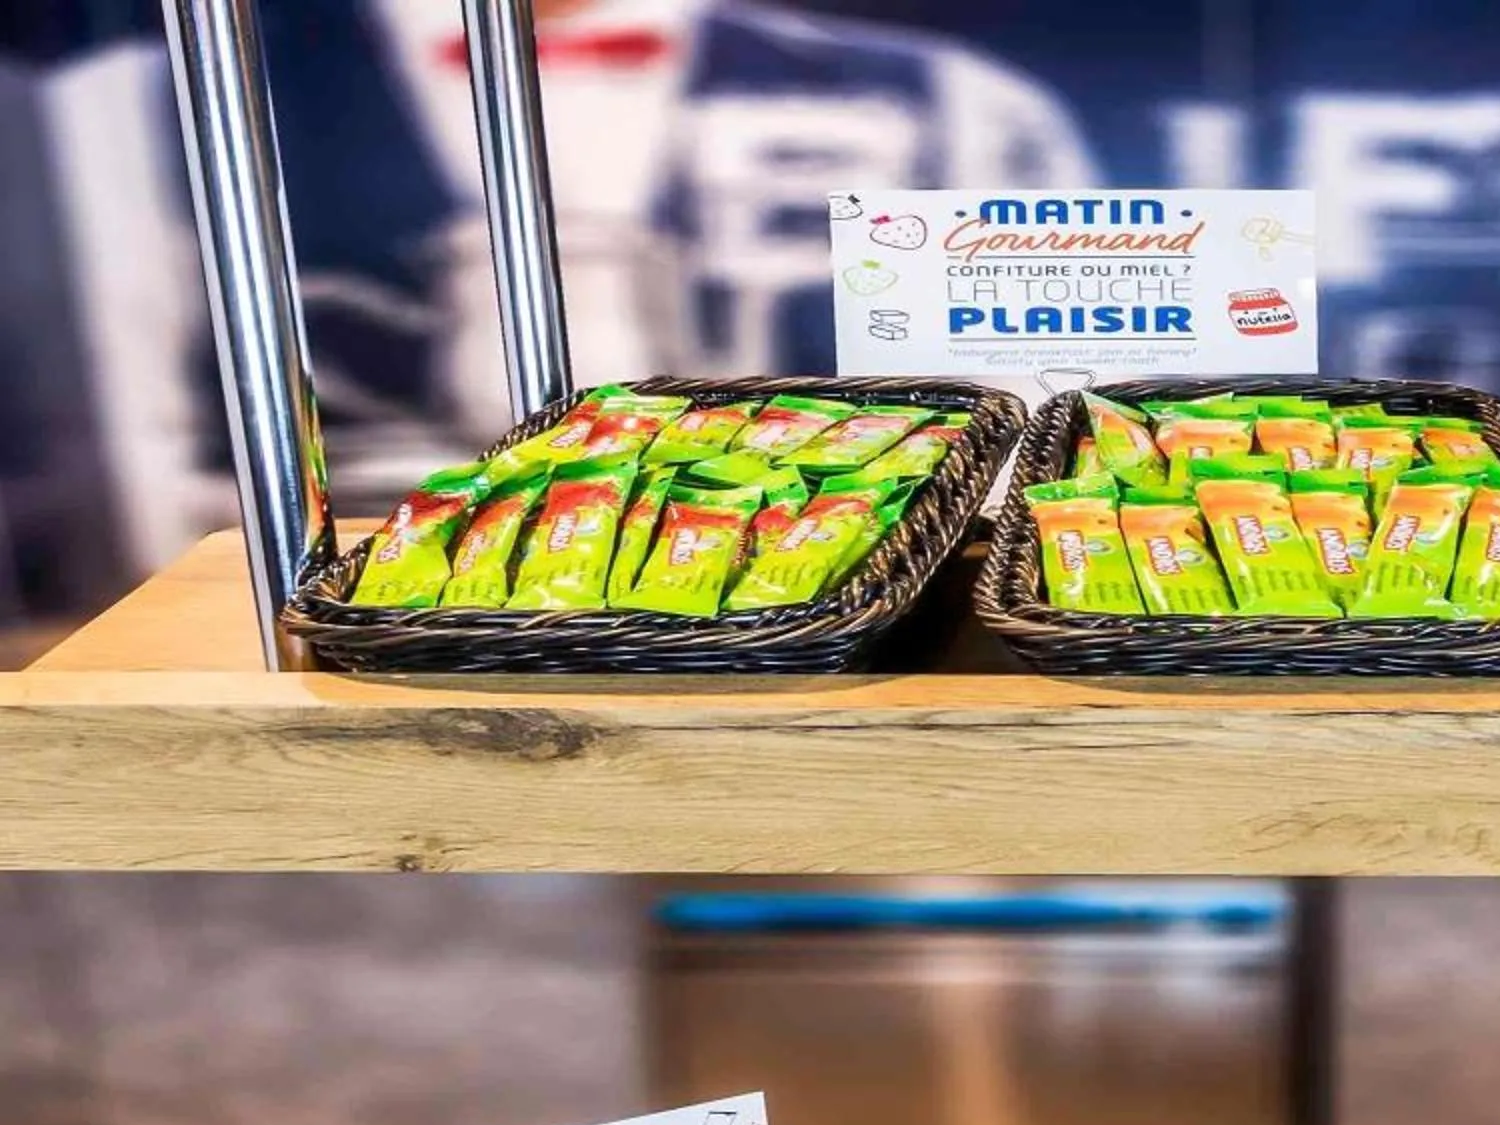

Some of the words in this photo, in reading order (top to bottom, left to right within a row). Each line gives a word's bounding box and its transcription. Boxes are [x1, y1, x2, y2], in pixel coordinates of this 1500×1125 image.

[979, 199, 1165, 226] MATIN
[943, 217, 1206, 263] Gourmand
[946, 265, 1072, 278] CONFITURE
[1081, 265, 1113, 278] OU
[1121, 265, 1175, 278] MIEL
[946, 279, 999, 303] LA
[1014, 279, 1193, 303] TOUCHE
[948, 307, 1193, 334] PLAISIR
